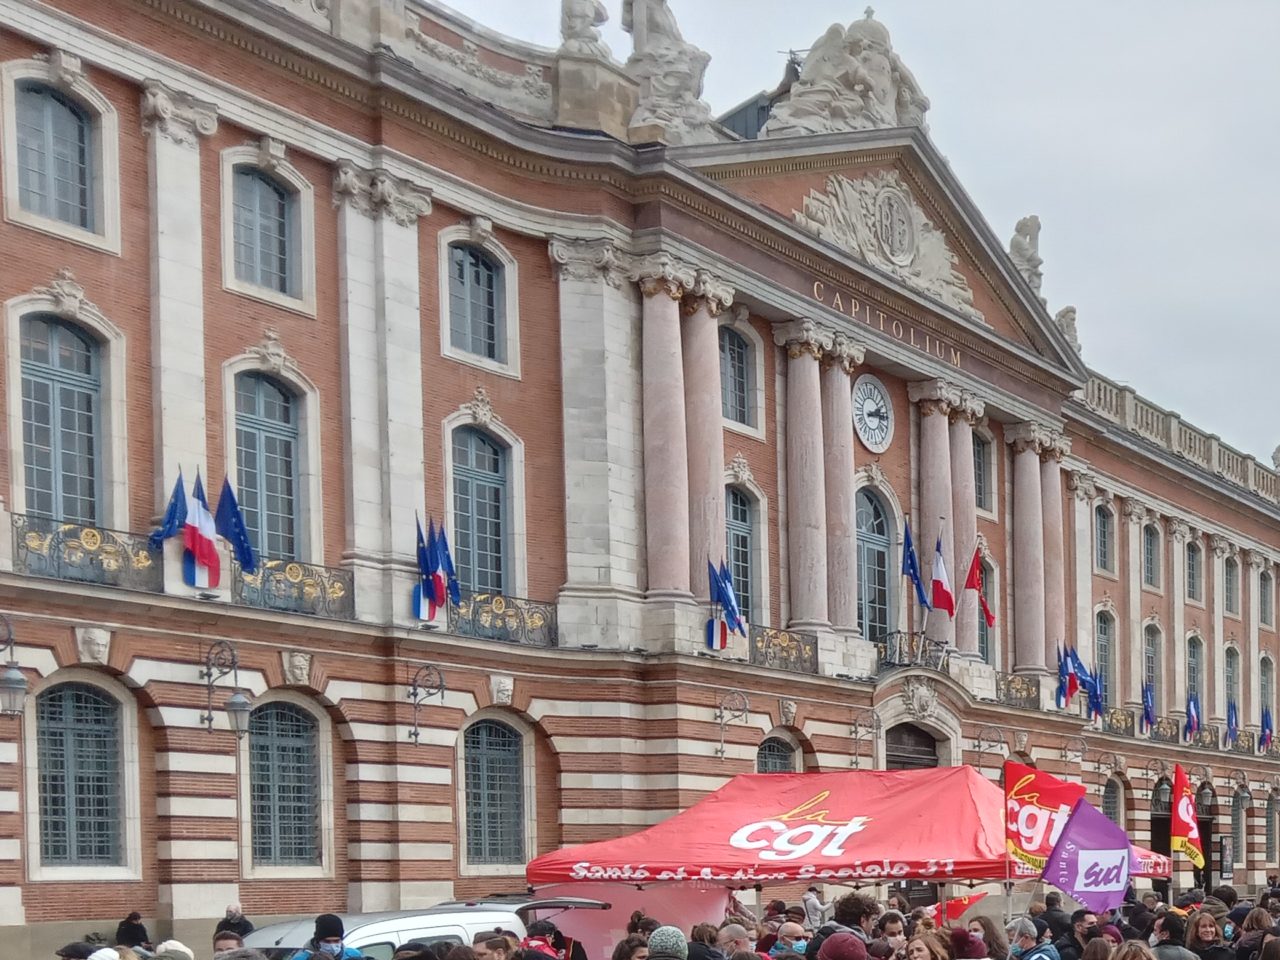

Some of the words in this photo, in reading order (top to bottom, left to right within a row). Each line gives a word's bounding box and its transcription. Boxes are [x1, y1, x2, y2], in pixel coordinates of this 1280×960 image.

[813, 281, 962, 368] CAPITOLIUM
[729, 815, 868, 860] cgt
[1007, 800, 1070, 851] cgt
[918, 858, 954, 876] 31
[1083, 855, 1125, 888] Sud
